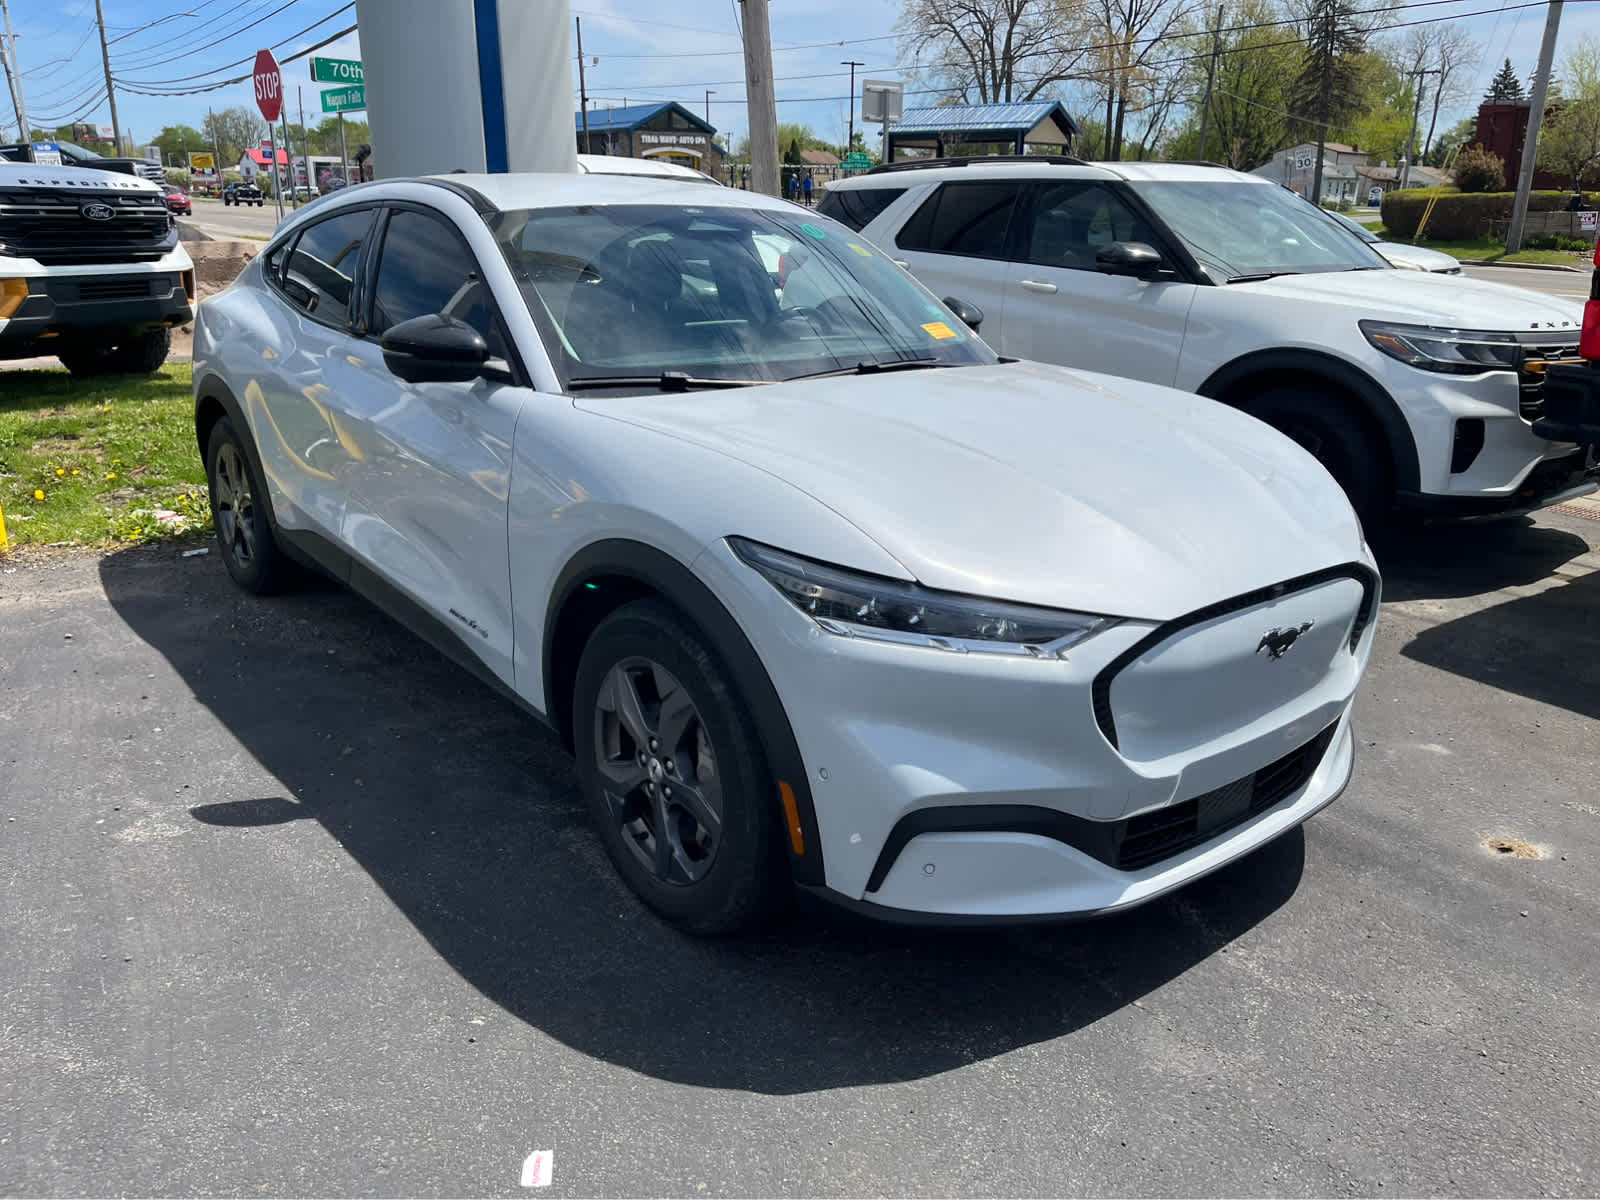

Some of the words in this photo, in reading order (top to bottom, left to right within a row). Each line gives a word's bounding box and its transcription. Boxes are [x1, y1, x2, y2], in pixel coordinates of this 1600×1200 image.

[330, 62, 364, 79] 70th
[255, 71, 279, 100] STOP
[326, 93, 347, 107] Niagara
[347, 89, 362, 105] Falls
[1297, 158, 1311, 168] 30
[18, 178, 141, 189] EXPEDITION
[88, 205, 111, 218] Ford
